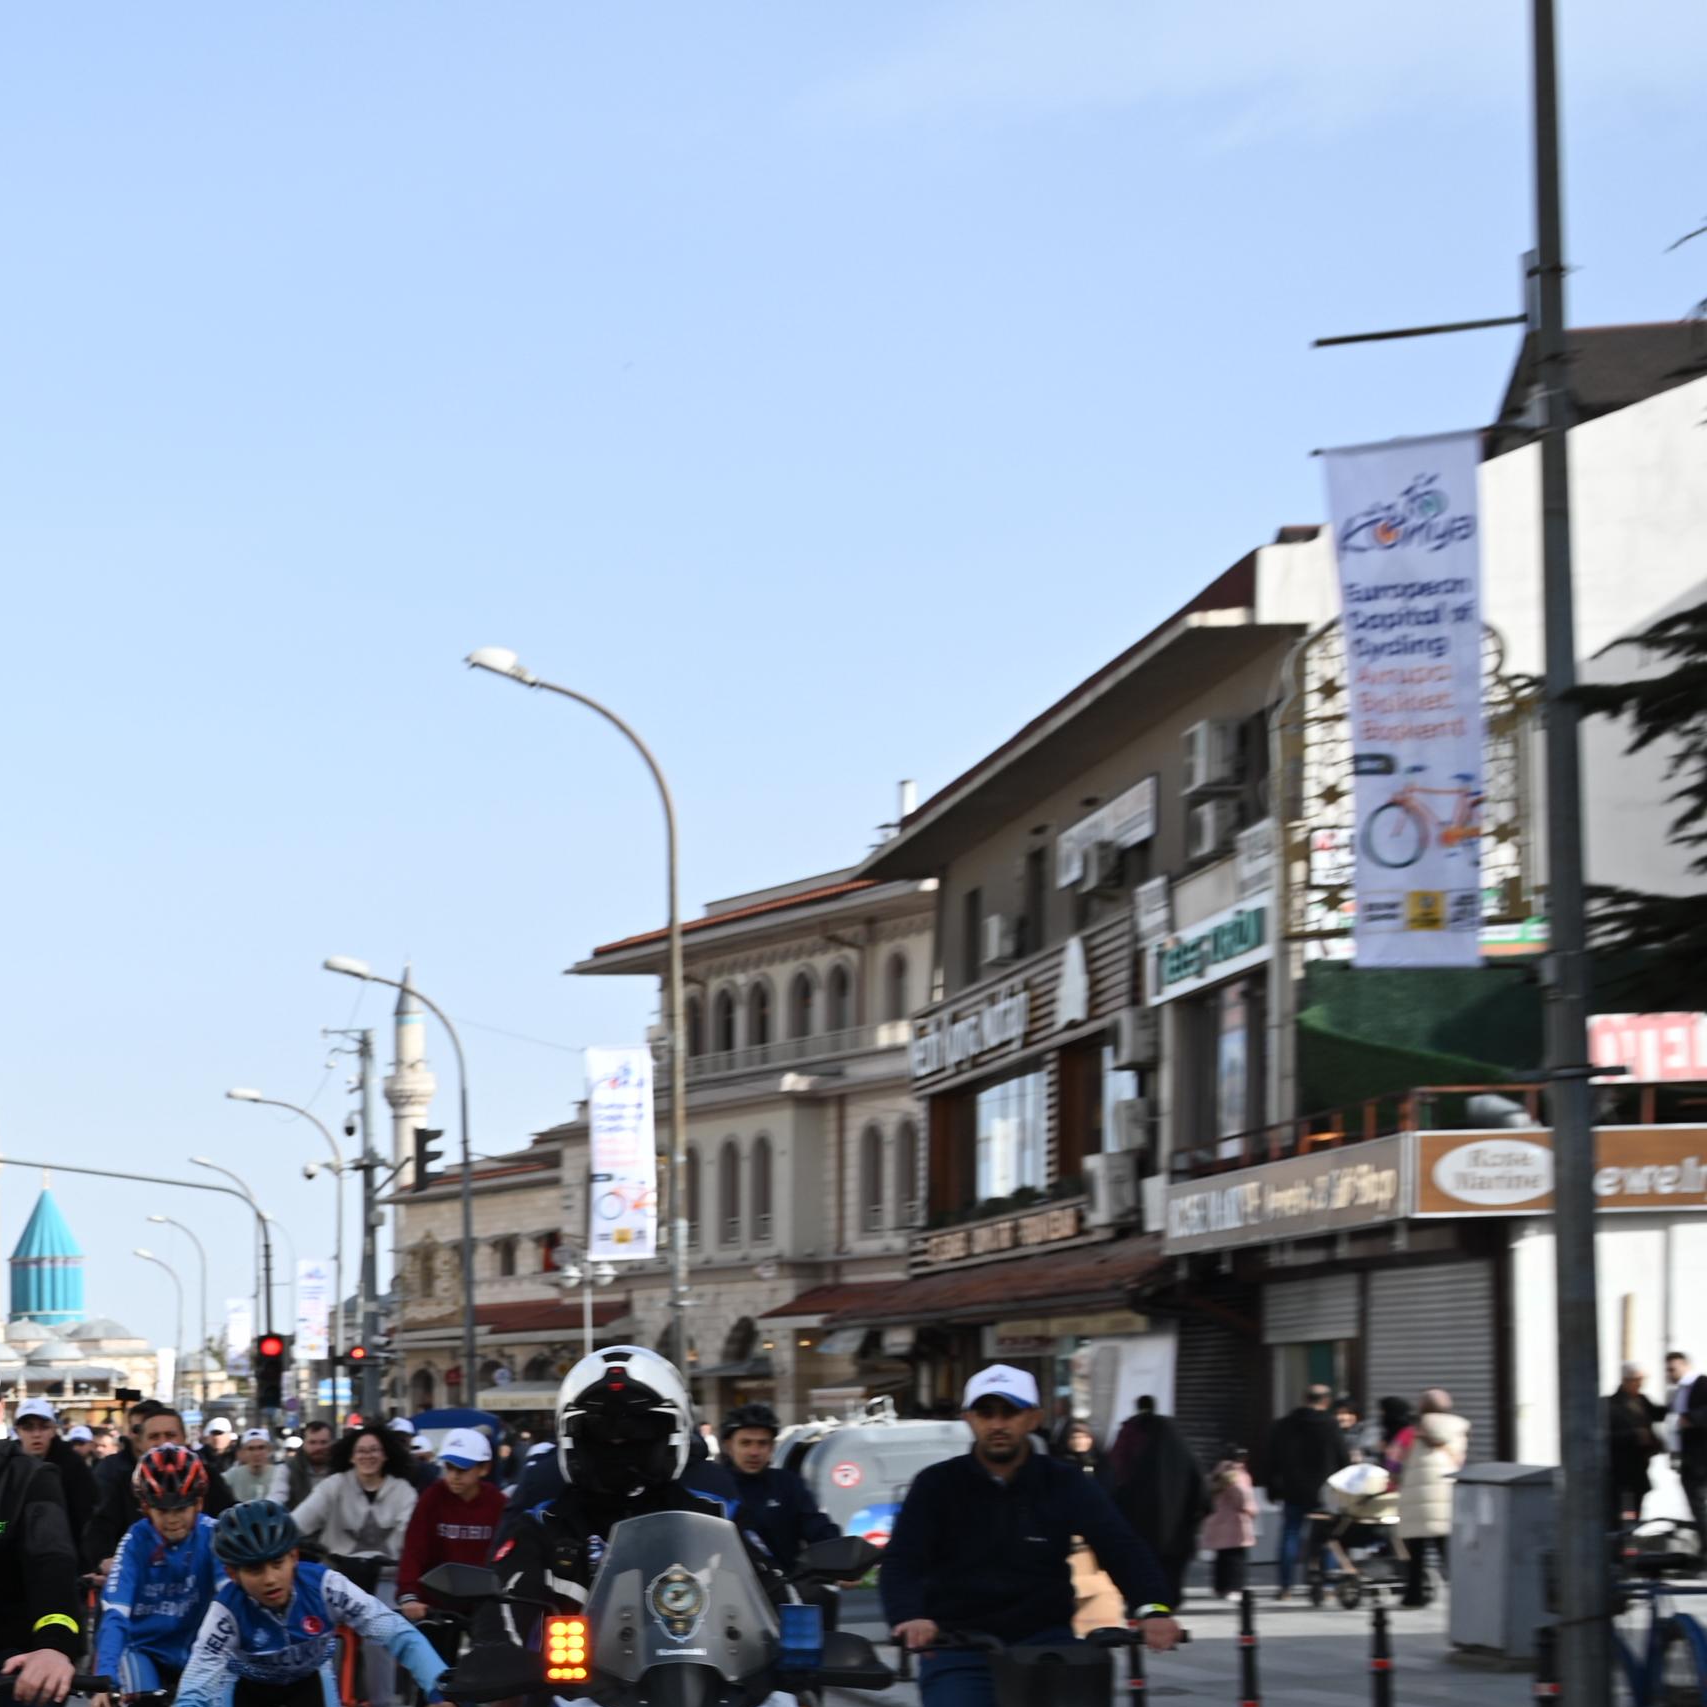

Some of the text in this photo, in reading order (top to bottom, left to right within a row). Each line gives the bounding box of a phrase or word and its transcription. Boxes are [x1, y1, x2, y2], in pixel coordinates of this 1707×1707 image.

[1344, 575, 1473, 605] European
[1347, 600, 1475, 634] Capital of
[1350, 634, 1450, 664] Cycling
